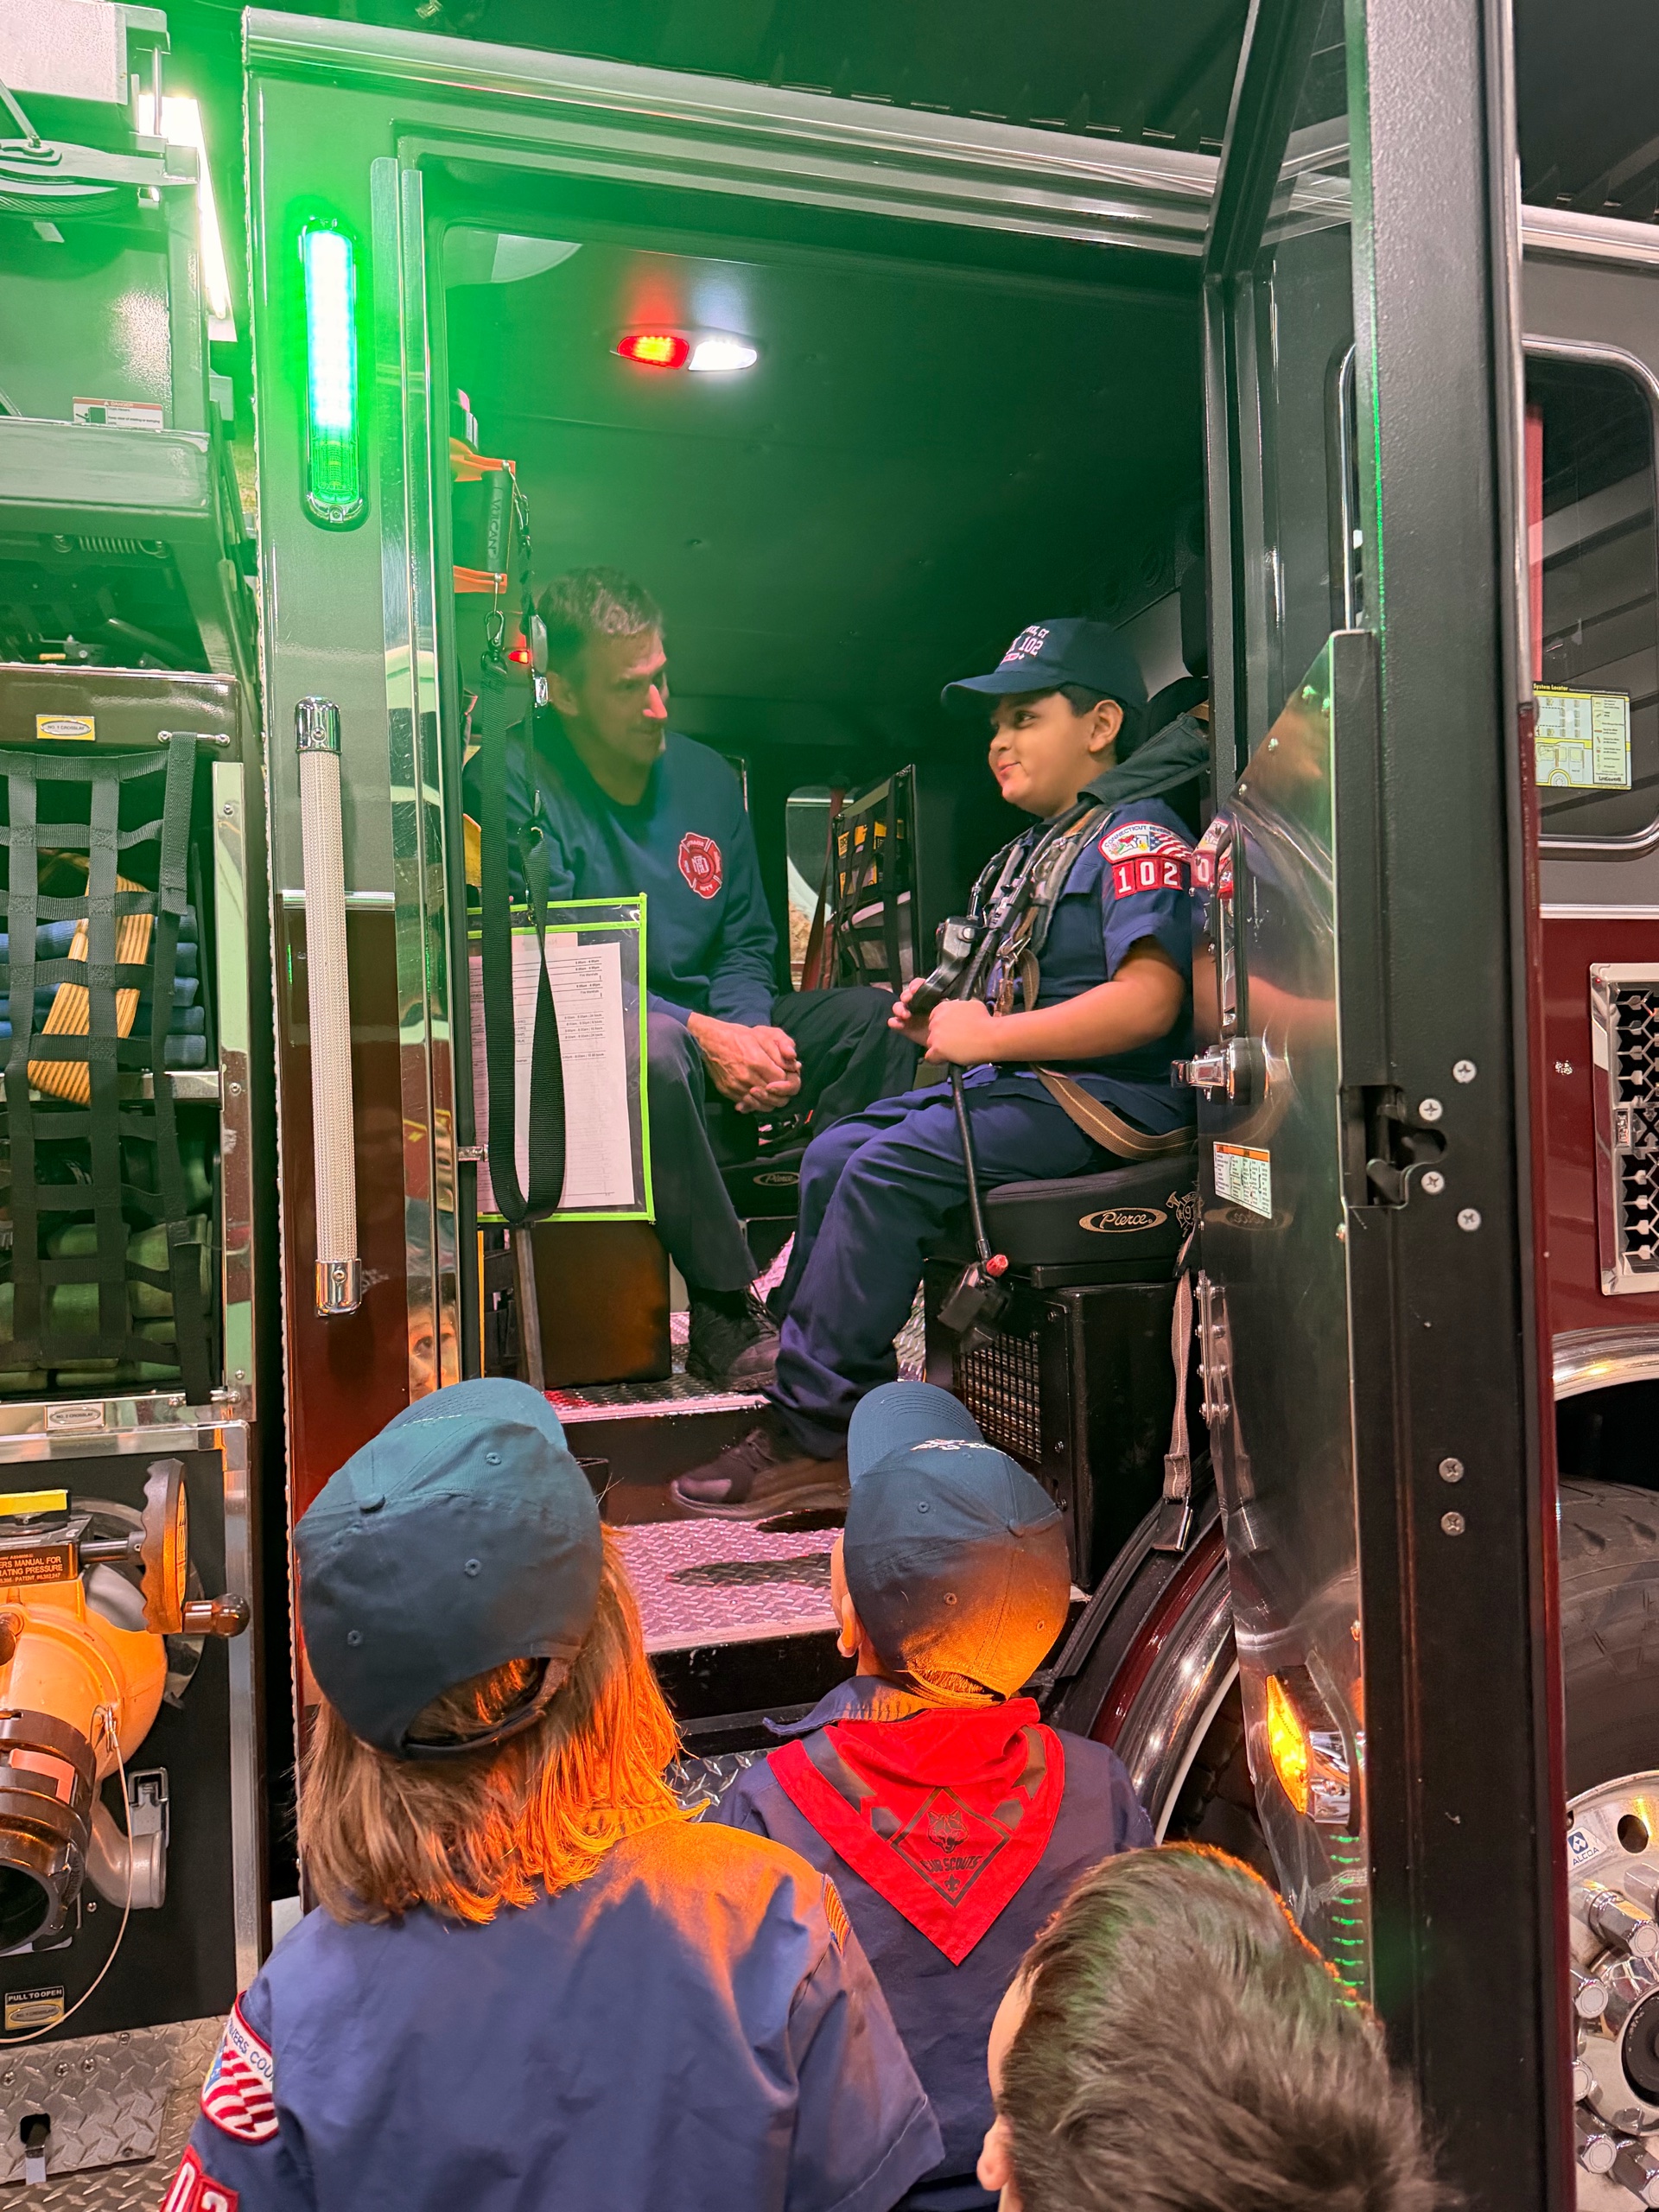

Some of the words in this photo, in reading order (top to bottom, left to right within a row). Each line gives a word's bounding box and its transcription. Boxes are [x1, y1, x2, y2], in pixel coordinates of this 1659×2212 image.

[1018, 636, 1044, 657] 102
[1104, 825, 1147, 848] CONNECTICUT
[1117, 861, 1178, 893] 102
[1099, 1211, 1148, 1229] Pierce
[15, 1558, 44, 1567] MANUAL
[25, 1564, 63, 1574] PRESSURE
[943, 1856, 982, 1872] SCOUTS
[1573, 1847, 1599, 1866] ALCOA
[9, 1993, 28, 2002] PULL
[41, 1989, 62, 1998] OPEN
